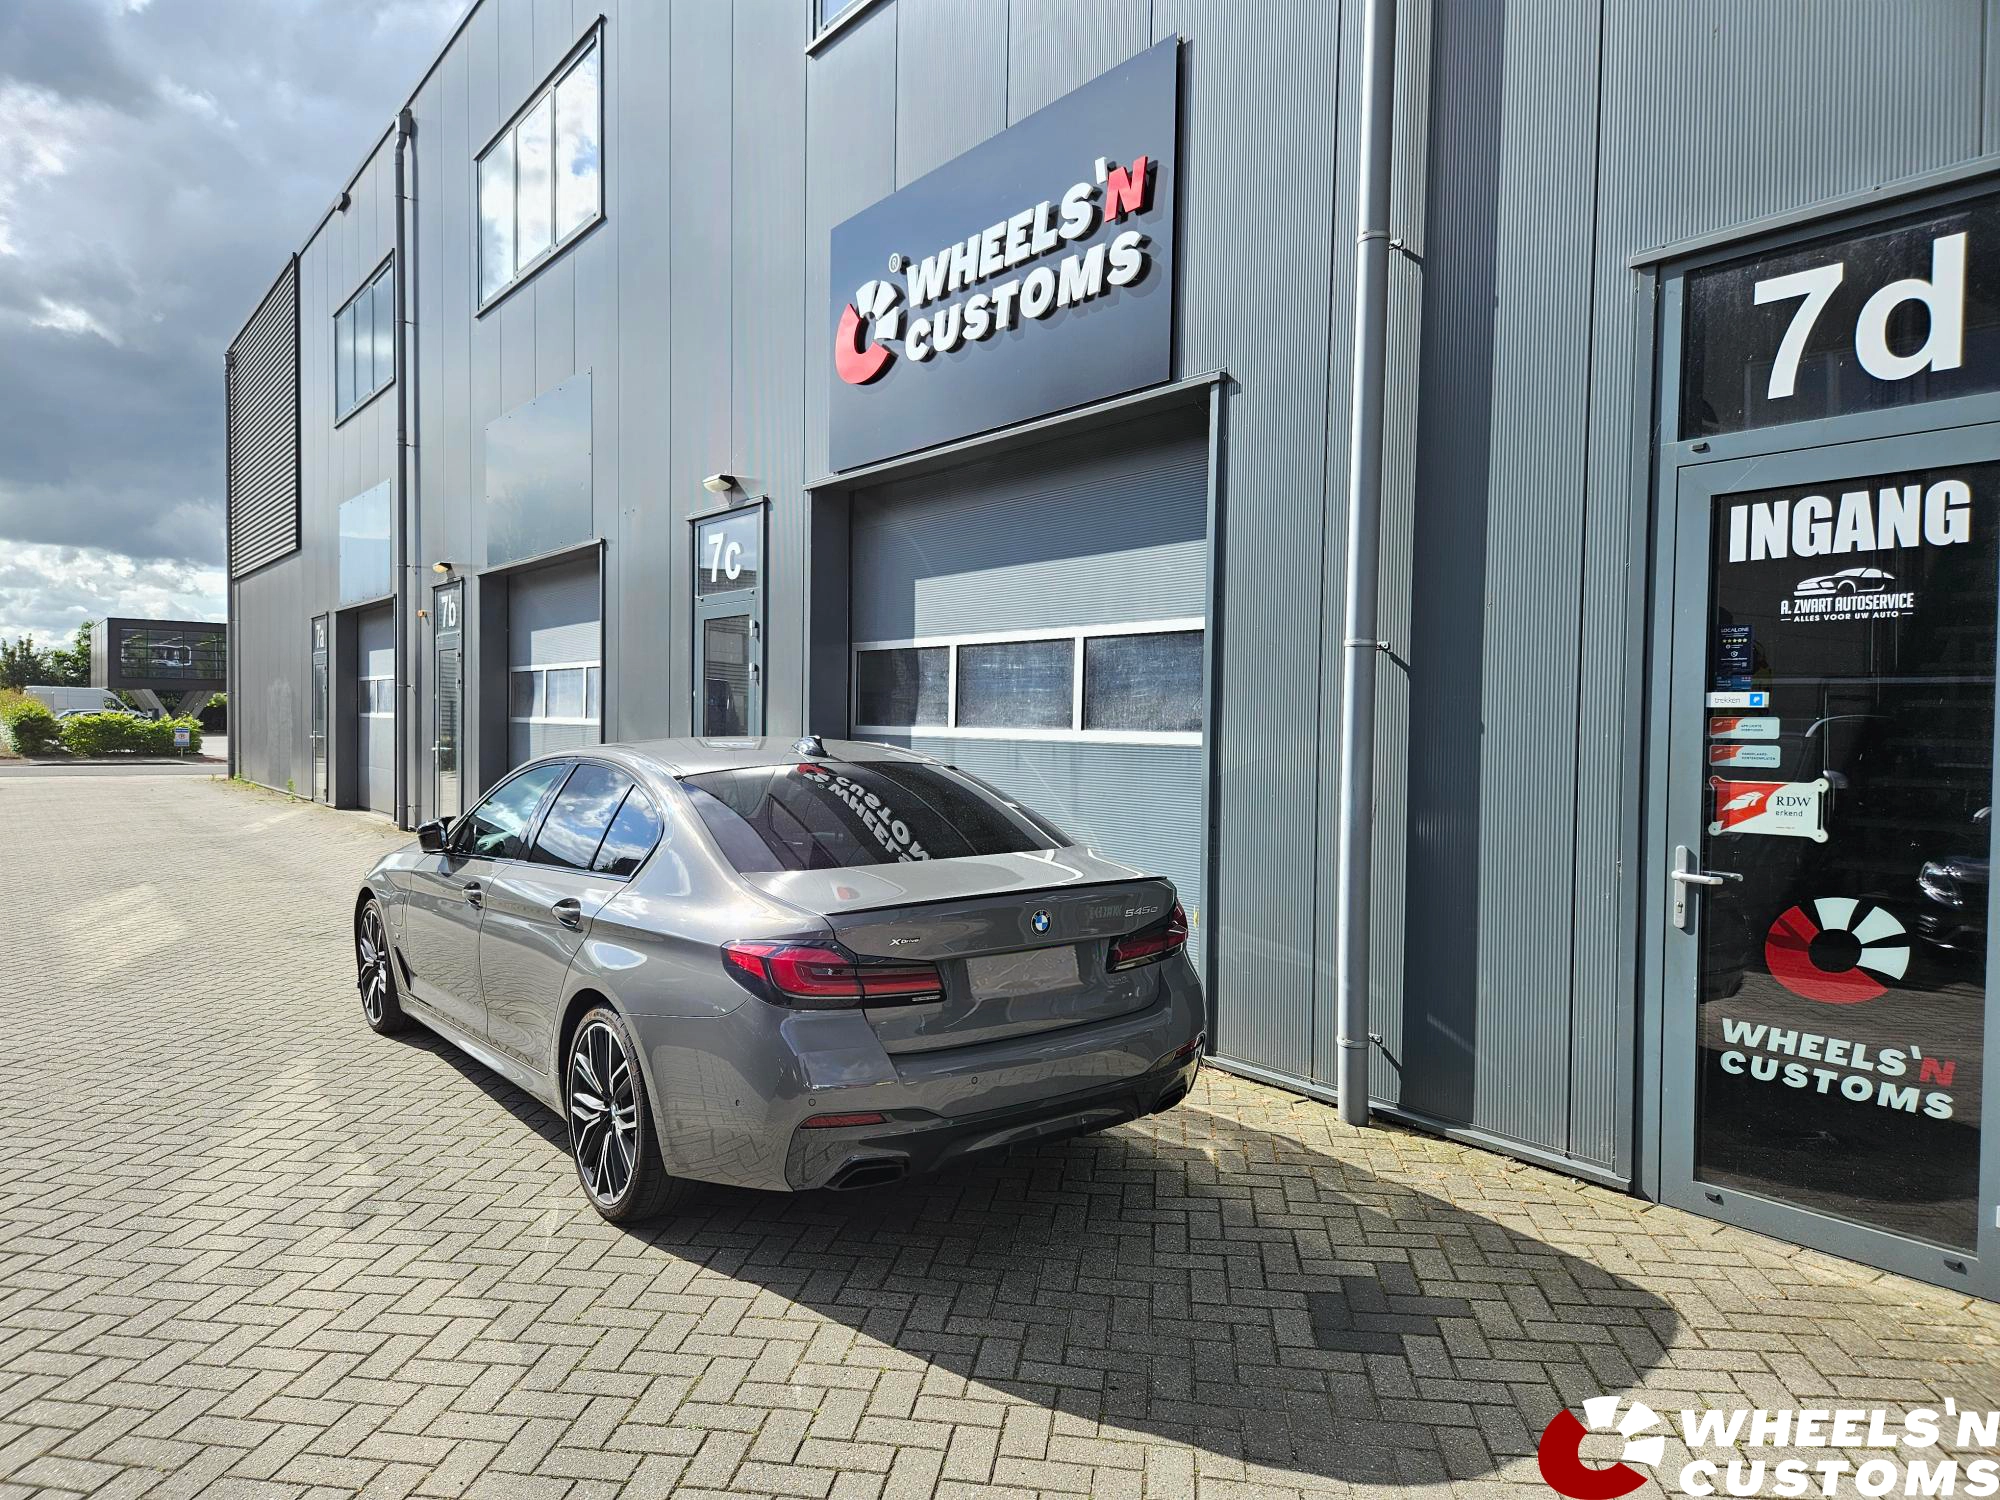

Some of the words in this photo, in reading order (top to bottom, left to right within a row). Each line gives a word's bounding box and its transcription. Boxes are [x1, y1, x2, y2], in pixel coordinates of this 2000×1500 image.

[905, 230, 1144, 362] CUSTOMS
[1753, 231, 1968, 400] 7d
[1728, 479, 1972, 563] INGANG
[708, 532, 742, 583] 7c
[440, 593, 457, 628] 7b
[1780, 600, 1792, 615] A.
[1793, 597, 1833, 614] ZWART
[1834, 592, 1915, 612] AUTOSERVICE
[1793, 614, 1820, 623] ALLES
[1823, 613, 1851, 621] VOOR
[1854, 612, 1870, 620] UW
[1872, 610, 1899, 619] AUTO
[315, 624, 325, 649] 7a
[1775, 809, 1803, 817] erkend
[1776, 796, 1812, 807] RDW
[1720, 1050, 1954, 1120] CUSTOMS
